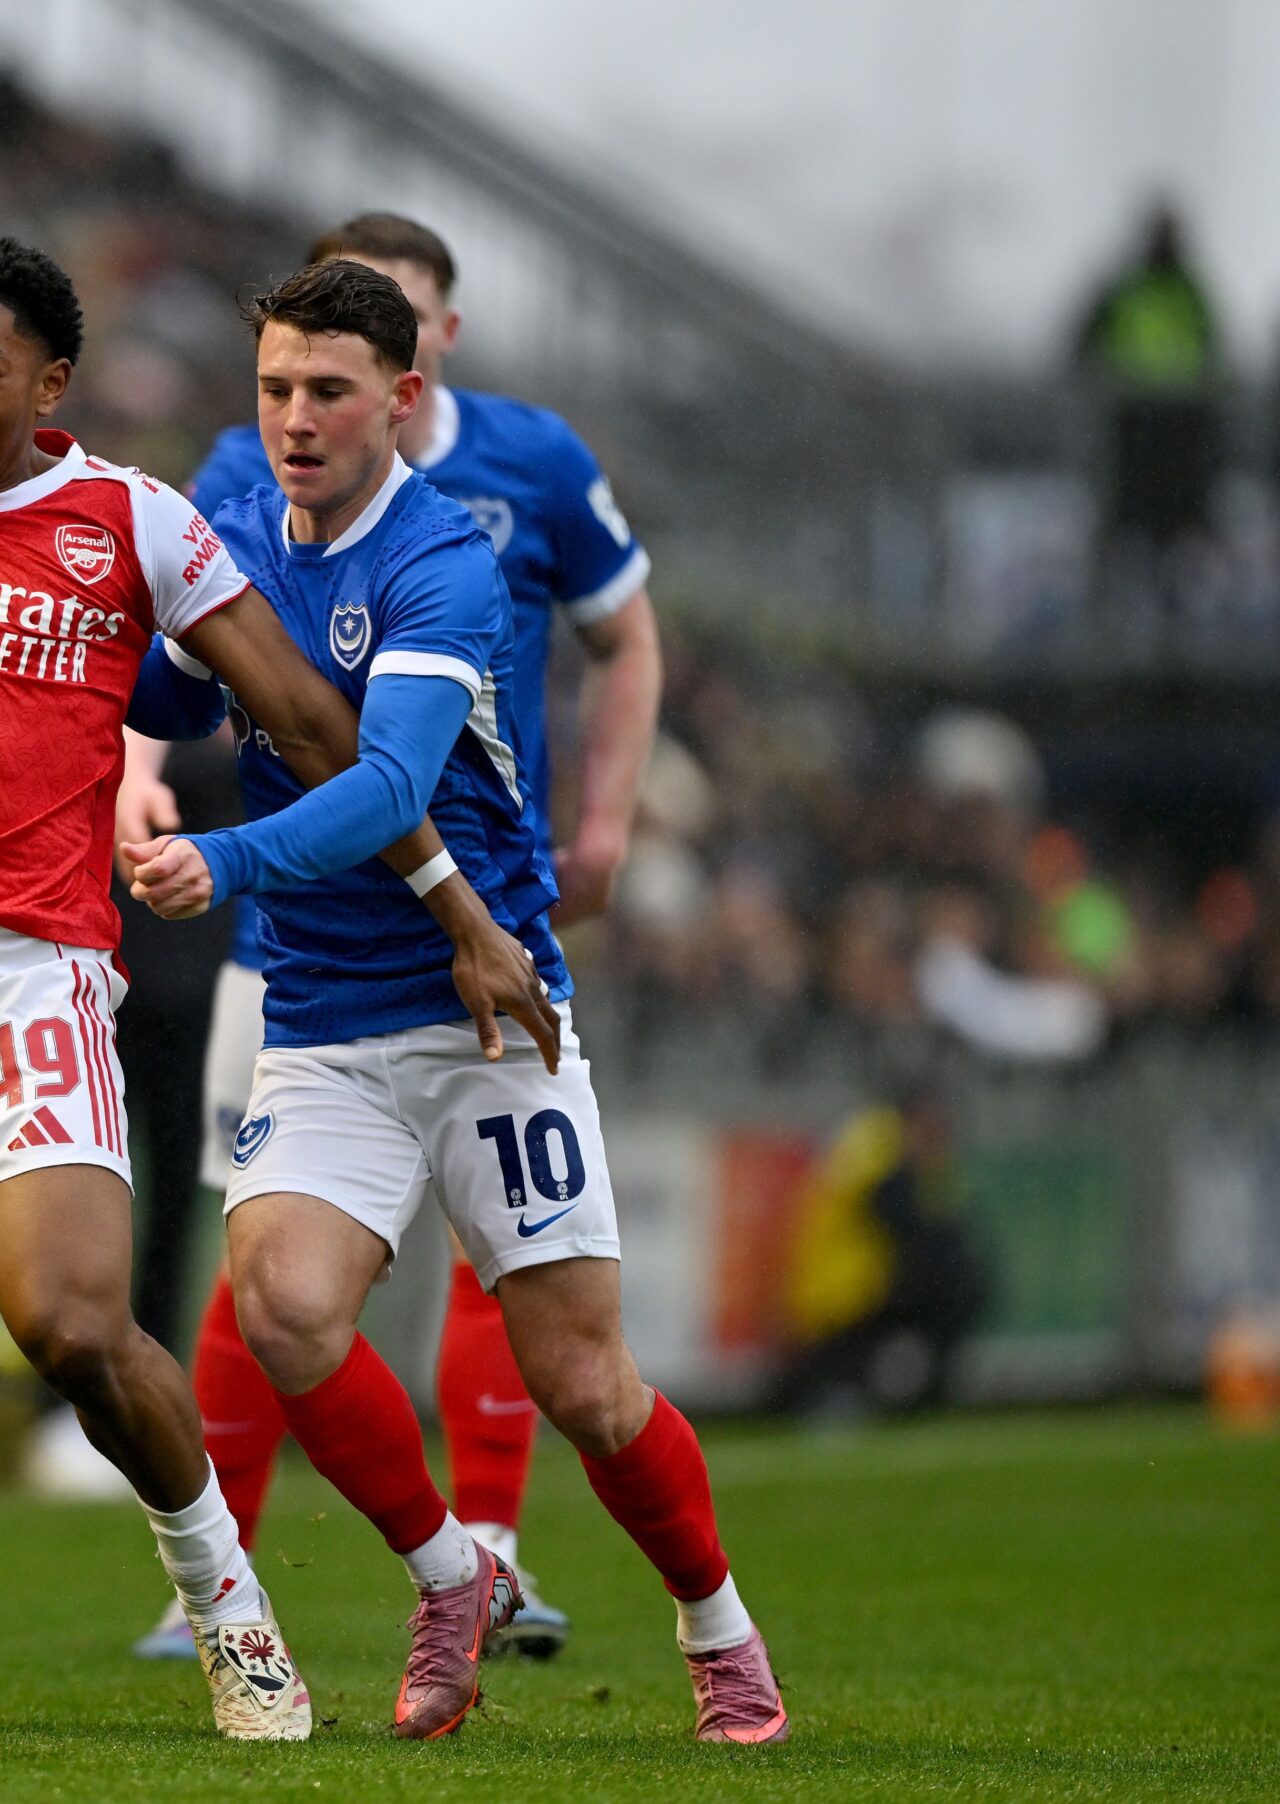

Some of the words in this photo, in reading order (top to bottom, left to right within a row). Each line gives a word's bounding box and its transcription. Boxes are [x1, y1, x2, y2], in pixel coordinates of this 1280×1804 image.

[64, 533, 107, 547] Arsenal
[182, 512, 209, 544] VIS
[476, 1108, 586, 1209] 10
